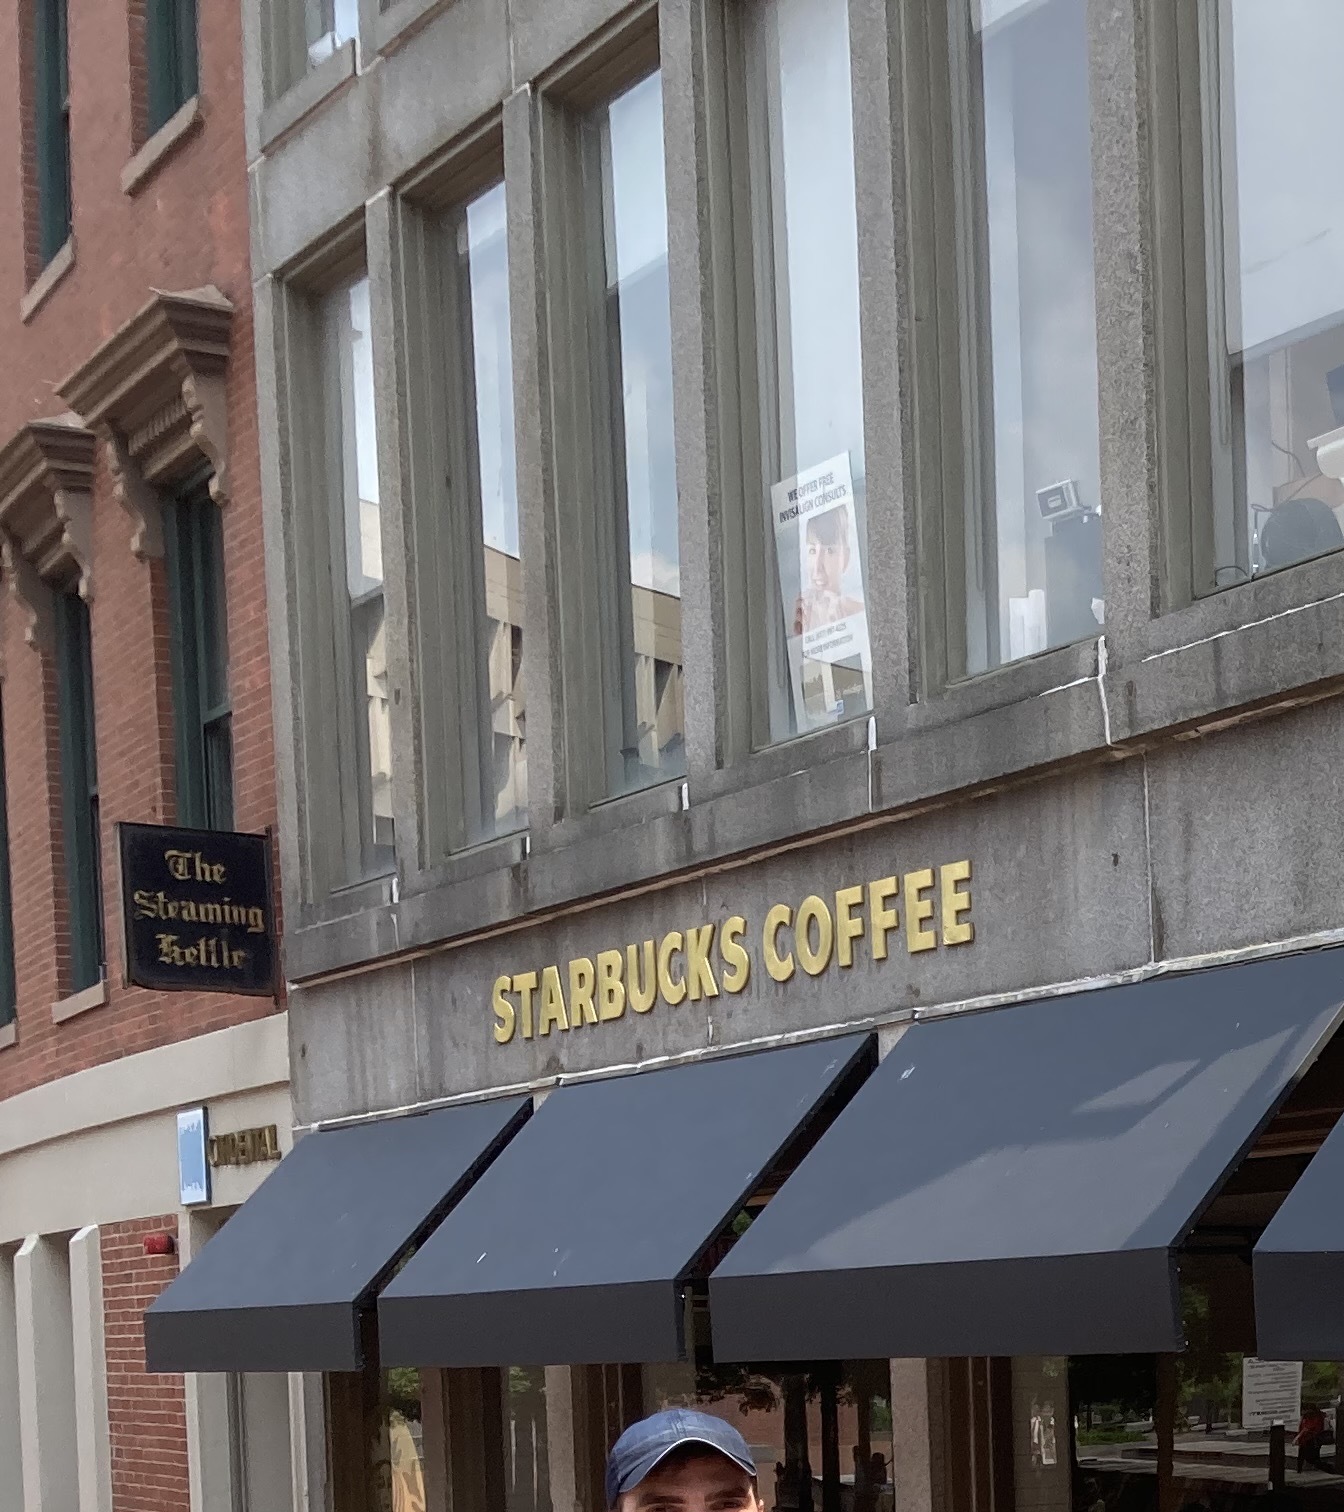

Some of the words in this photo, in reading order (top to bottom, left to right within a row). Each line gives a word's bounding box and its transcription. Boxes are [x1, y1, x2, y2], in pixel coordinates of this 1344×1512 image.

[164, 850, 227, 884] The
[133, 889, 265, 933] Steaming
[493, 916, 751, 1044] STARBUCKS
[763, 859, 975, 983] COFFEE
